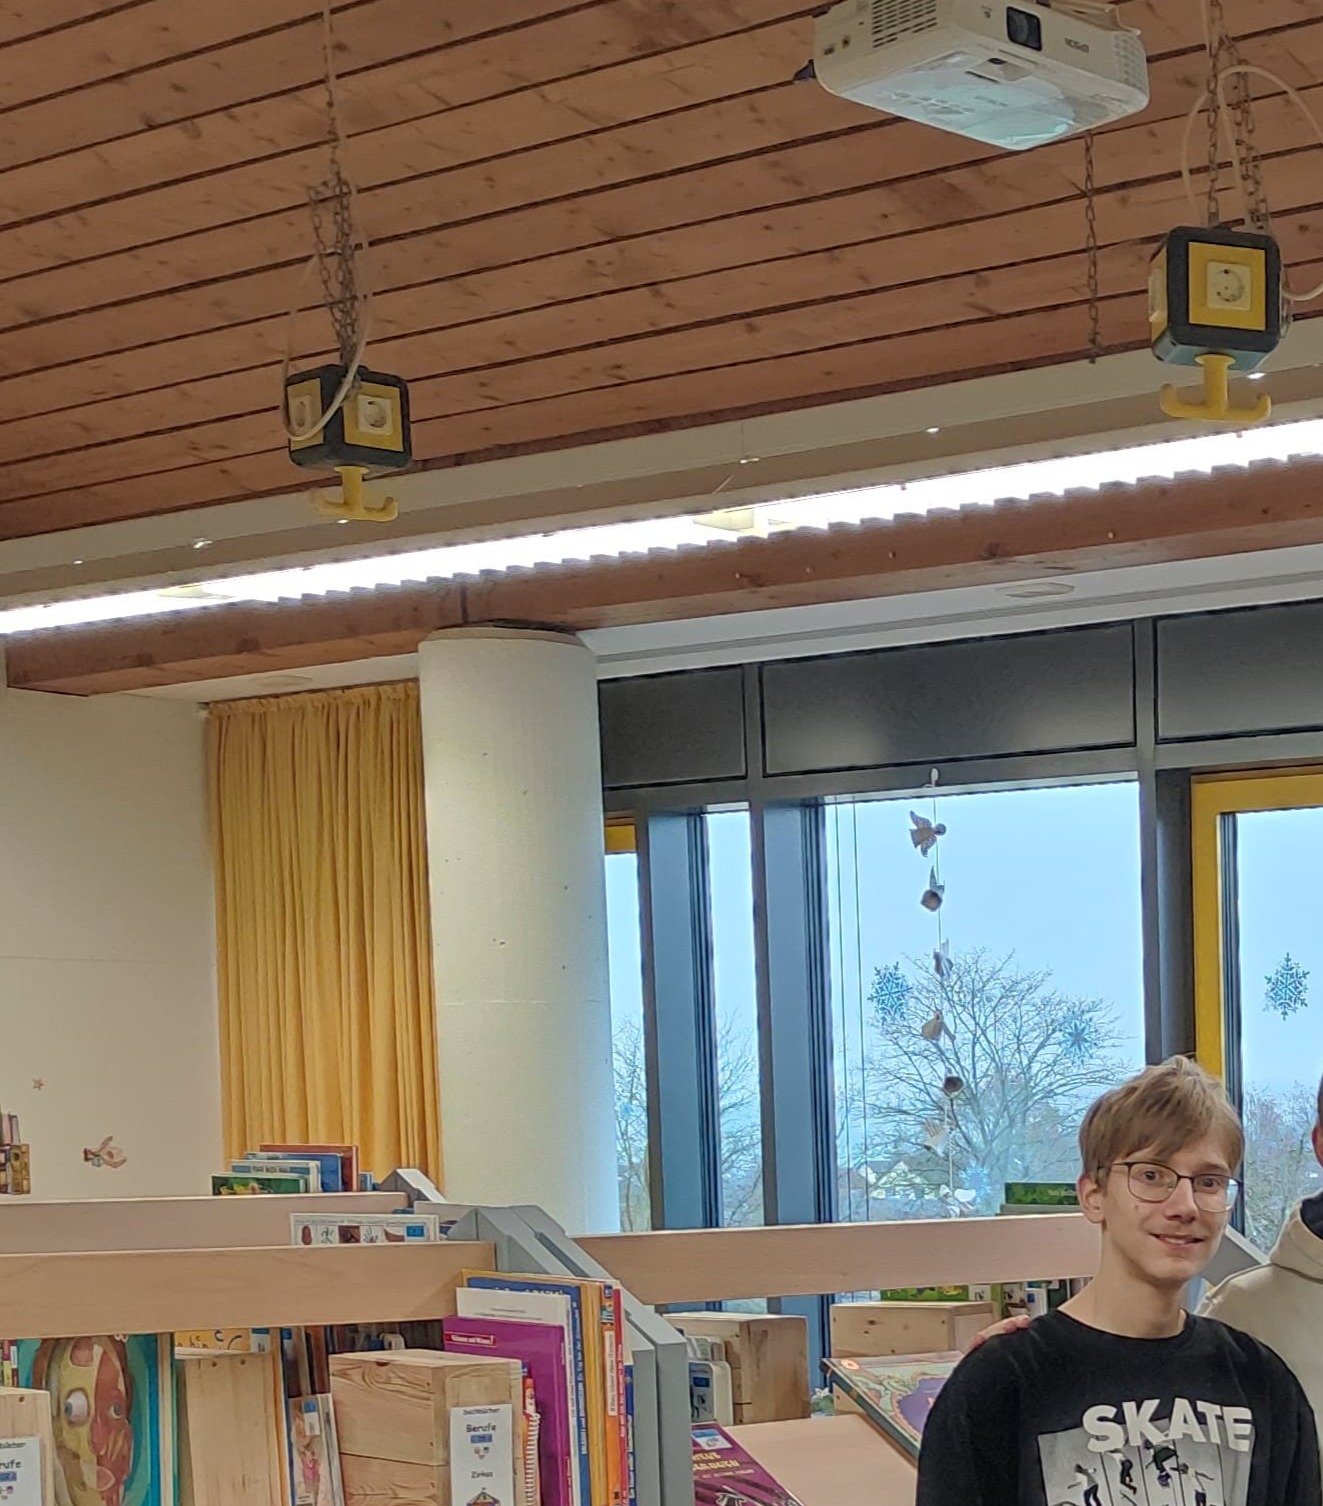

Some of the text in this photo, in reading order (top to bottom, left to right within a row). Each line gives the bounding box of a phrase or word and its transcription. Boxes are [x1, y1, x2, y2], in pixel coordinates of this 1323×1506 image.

[466, 1422, 496, 1433] Berufe
[1082, 1397, 1252, 1452] SKATE
[0, 1459, 22, 1469] rufe
